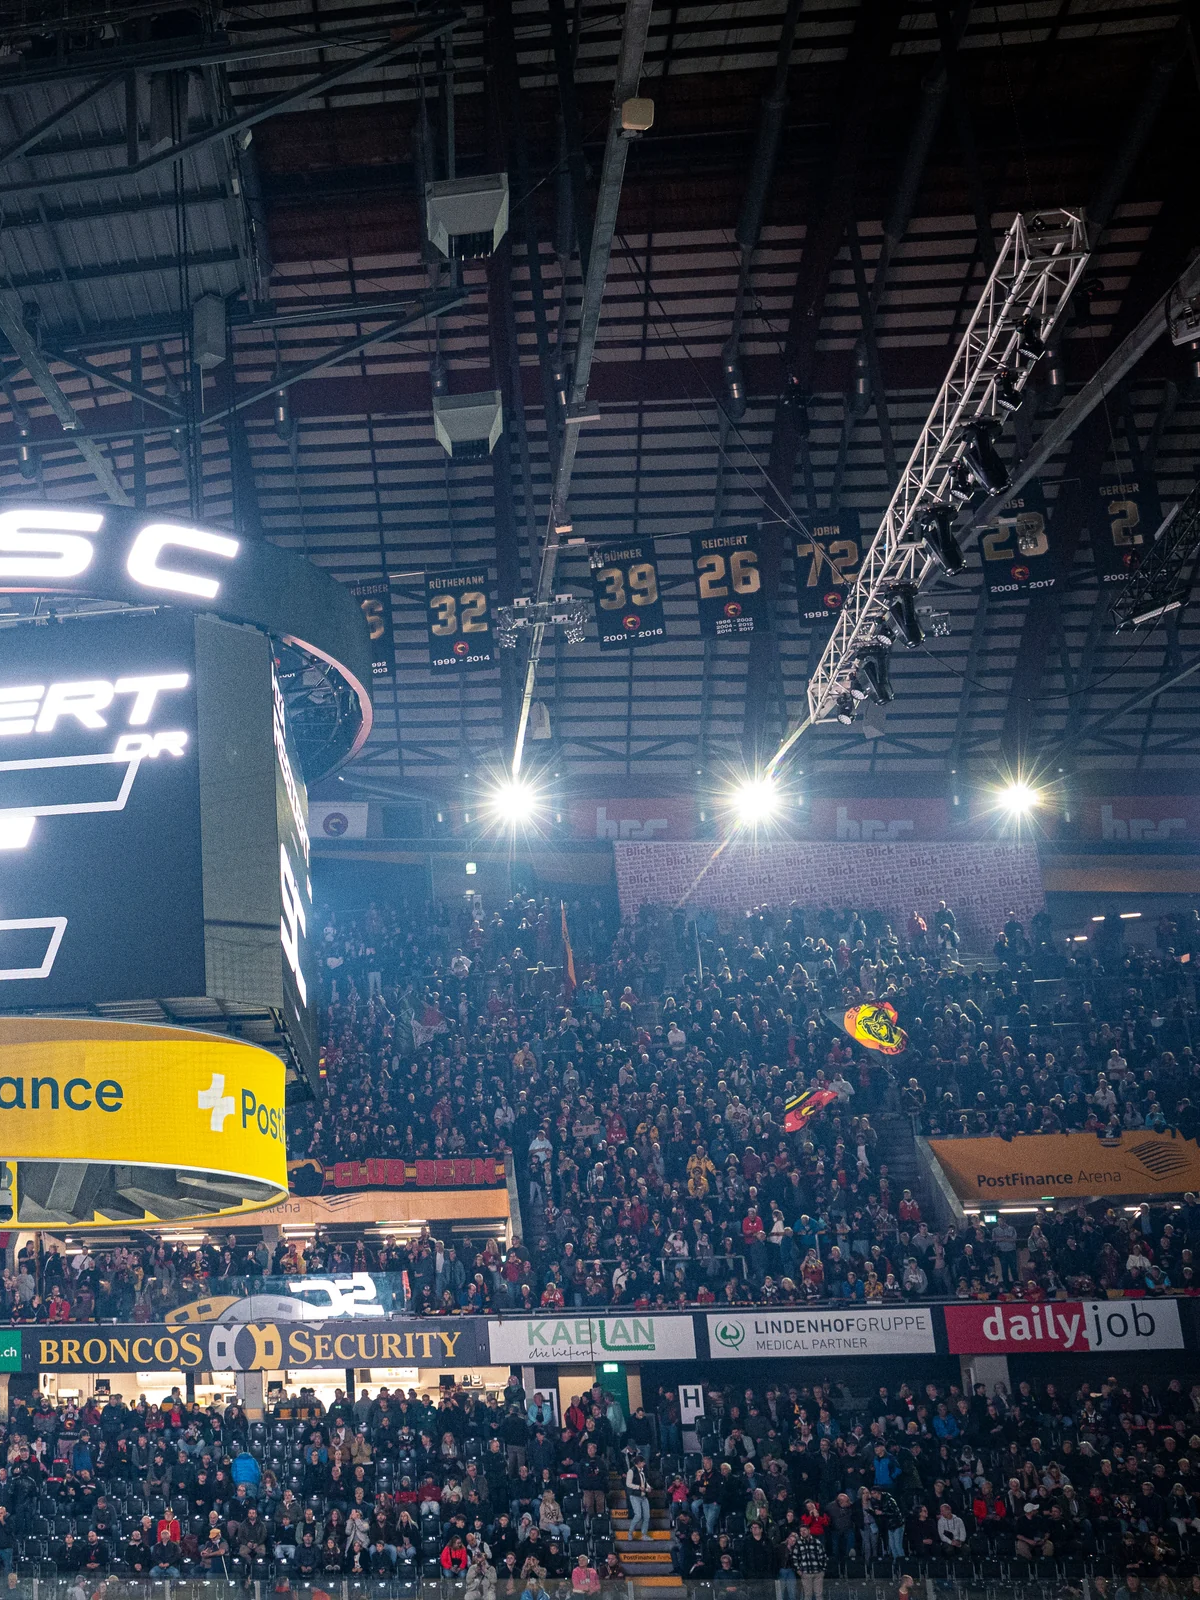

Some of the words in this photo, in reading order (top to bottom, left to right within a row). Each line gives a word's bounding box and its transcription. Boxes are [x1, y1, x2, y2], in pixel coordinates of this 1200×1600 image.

[1099, 483, 1140, 496] GERBER
[1108, 500, 1144, 546] 2
[812, 526, 840, 537] JOBIN
[702, 535, 748, 549] REICHERT
[604, 548, 643, 562] BÜHRER
[796, 540, 859, 587] 72
[697, 551, 761, 599] 26
[429, 576, 485, 589] RÜTHEMANN
[596, 563, 658, 611] 39
[990, 584, 1019, 593] 2008
[1029, 579, 1055, 589] 2017
[430, 592, 488, 636] 32
[603, 633, 628, 642] 2001
[639, 628, 663, 638] 2016
[433, 658, 456, 666] 1999
[467, 655, 491, 663] 2014
[113, 731, 189, 762] DR
[626, 846, 652, 857] Blick
[865, 846, 894, 857] Blick
[666, 855, 693, 866] Blick
[785, 856, 813, 867] Blick
[909, 856, 938, 867] Blick
[827, 865, 856, 877] Blick
[954, 866, 983, 877] Blick
[629, 874, 656, 885] Blick
[870, 875, 900, 887] Blick
[998, 876, 1029, 887] Blick
[789, 884, 817, 895] Blick
[913, 885, 943, 897] Blick
[958, 895, 988, 907] Blick
[333, 1158, 405, 1188] CLUB
[415, 1158, 497, 1186] BERN
[977, 1170, 1073, 1188] PostFinance
[1077, 1169, 1122, 1183] Arena
[754, 1316, 926, 1335] LINDENHOFGRUPPE
[982, 1303, 1155, 1348] daily.job
[527, 1318, 656, 1351] KABLAN
[39, 1332, 203, 1366] BRONCOS
[288, 1330, 461, 1365] SECURITY
[756, 1340, 808, 1350] MEDICAL
[812, 1338, 868, 1349] PARTNER
[683, 1388, 700, 1408] H
